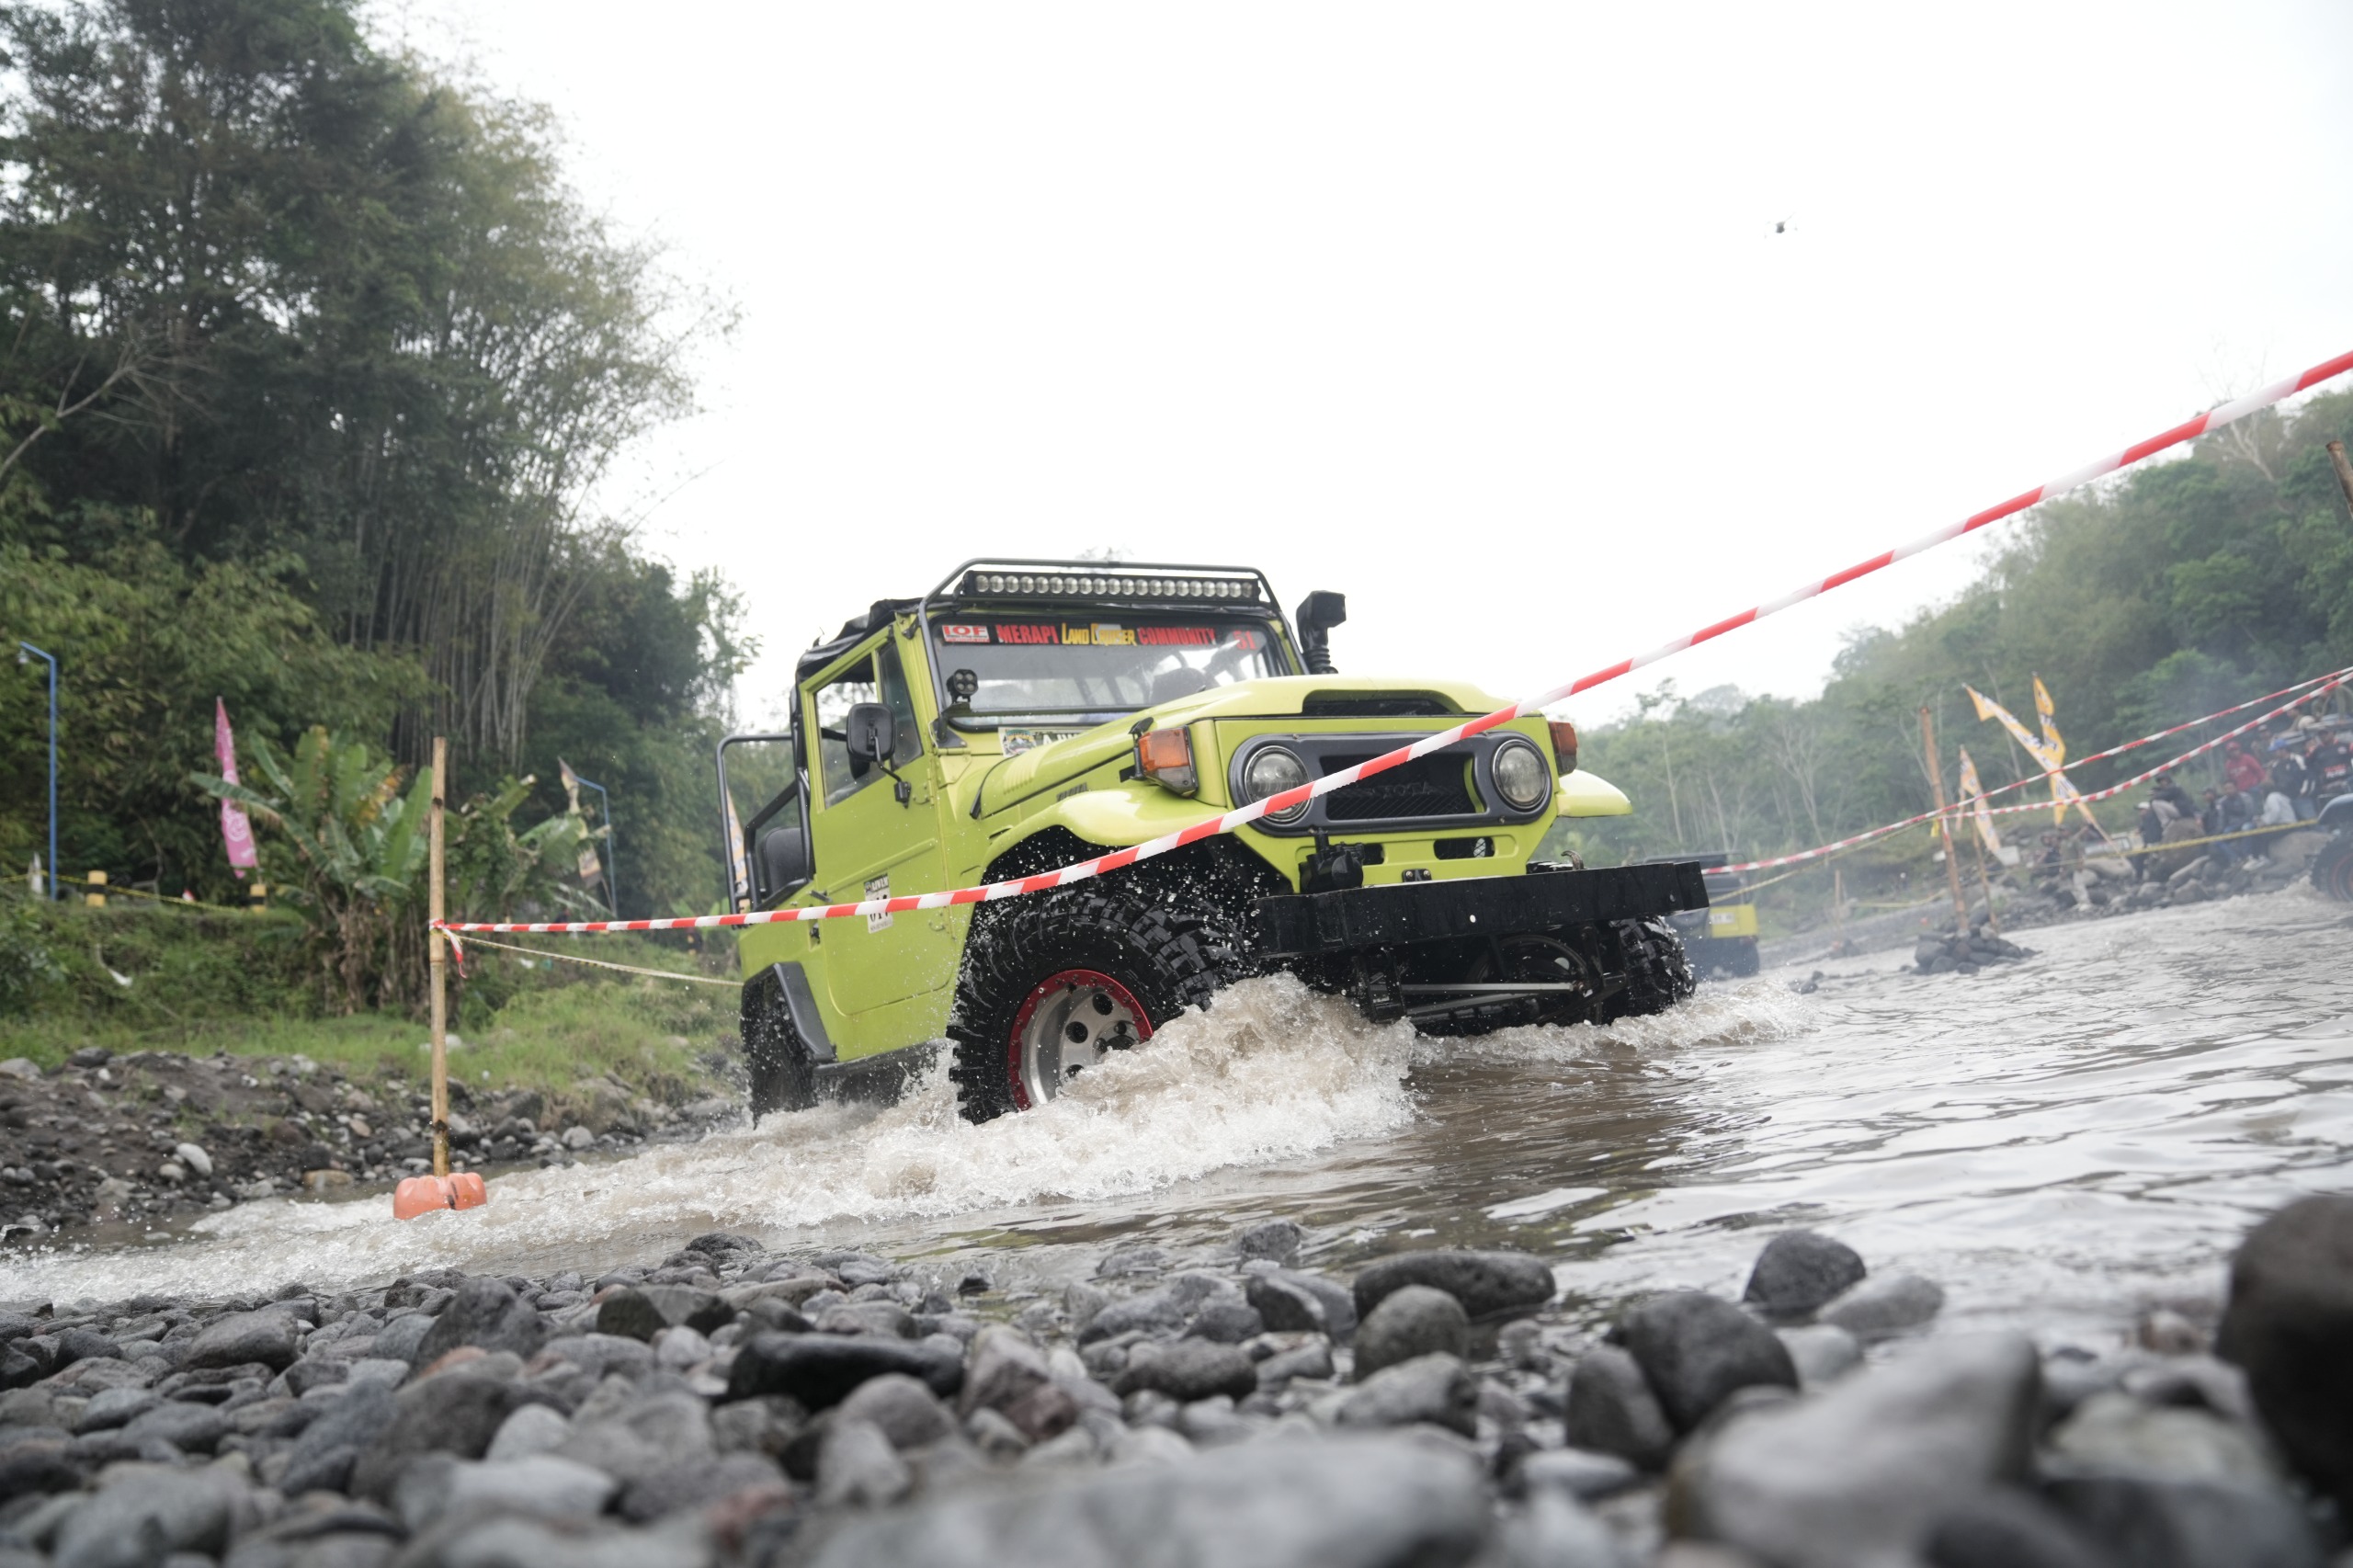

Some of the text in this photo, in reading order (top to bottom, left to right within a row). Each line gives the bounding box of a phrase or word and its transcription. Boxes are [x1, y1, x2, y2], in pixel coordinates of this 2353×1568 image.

[943, 625, 986, 635] IOF
[995, 624, 1059, 644] MERAPI
[1137, 626, 1216, 645] COMMUNITY
[1233, 630, 1258, 650] 51
